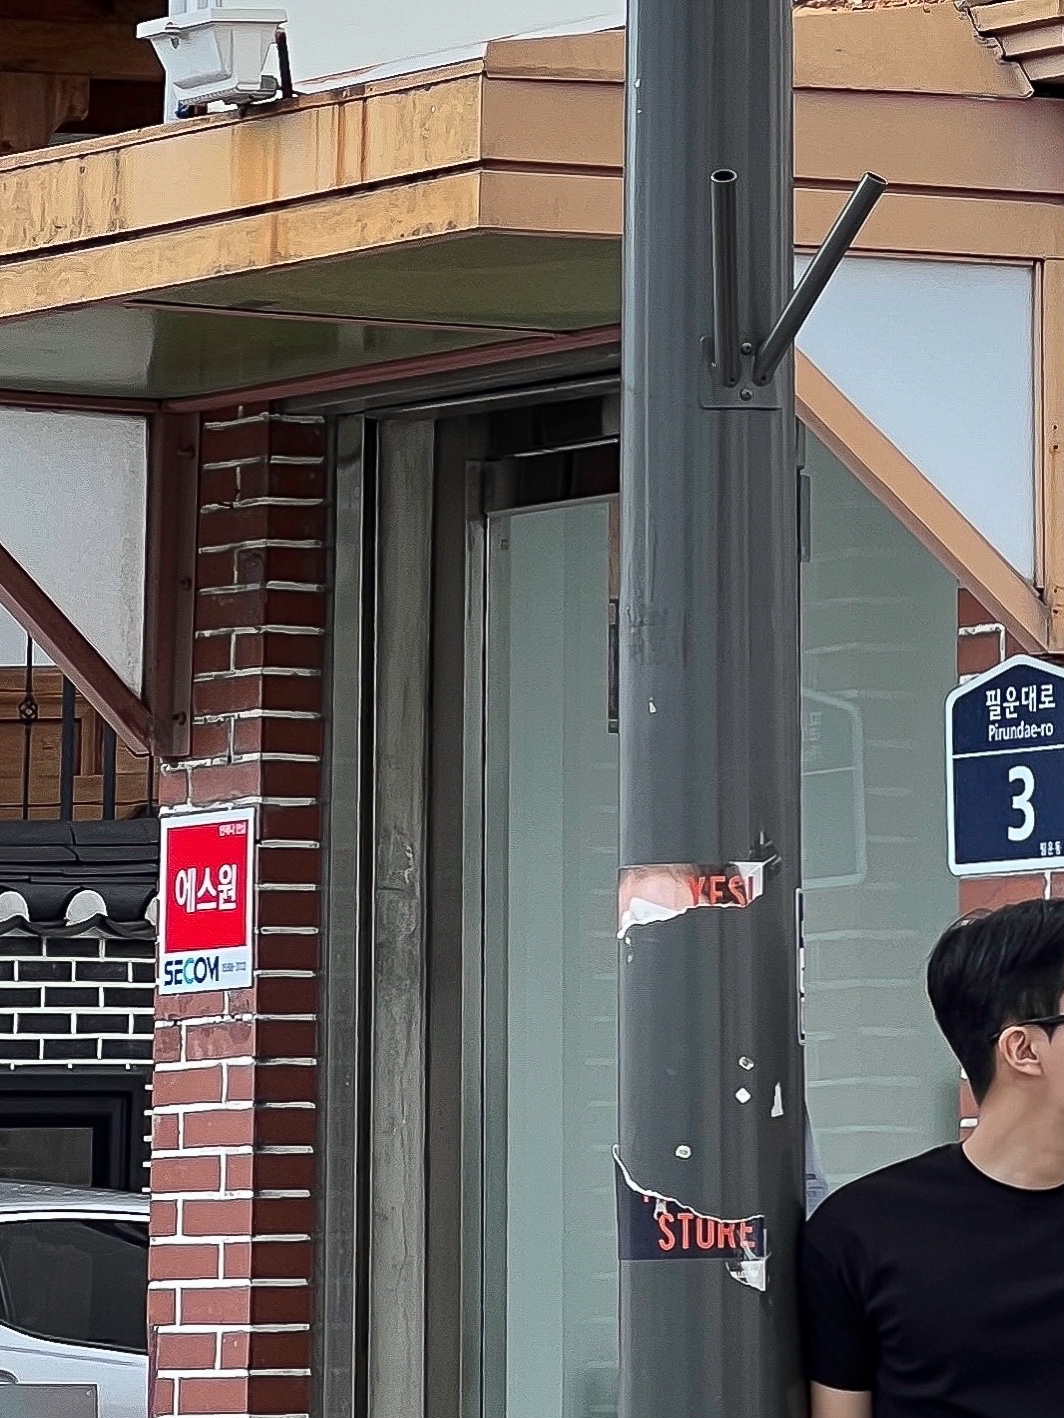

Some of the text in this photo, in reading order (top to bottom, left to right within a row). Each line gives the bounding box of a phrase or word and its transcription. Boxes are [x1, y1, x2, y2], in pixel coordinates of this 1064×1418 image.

[984, 684, 1055, 720] 필운대로
[988, 720, 1054, 741] Pirundae-ro
[1007, 765, 1036, 841] 3
[174, 864, 237, 914] 에스원
[164, 956, 219, 986] SECOM
[658, 1213, 755, 1251] STORE
